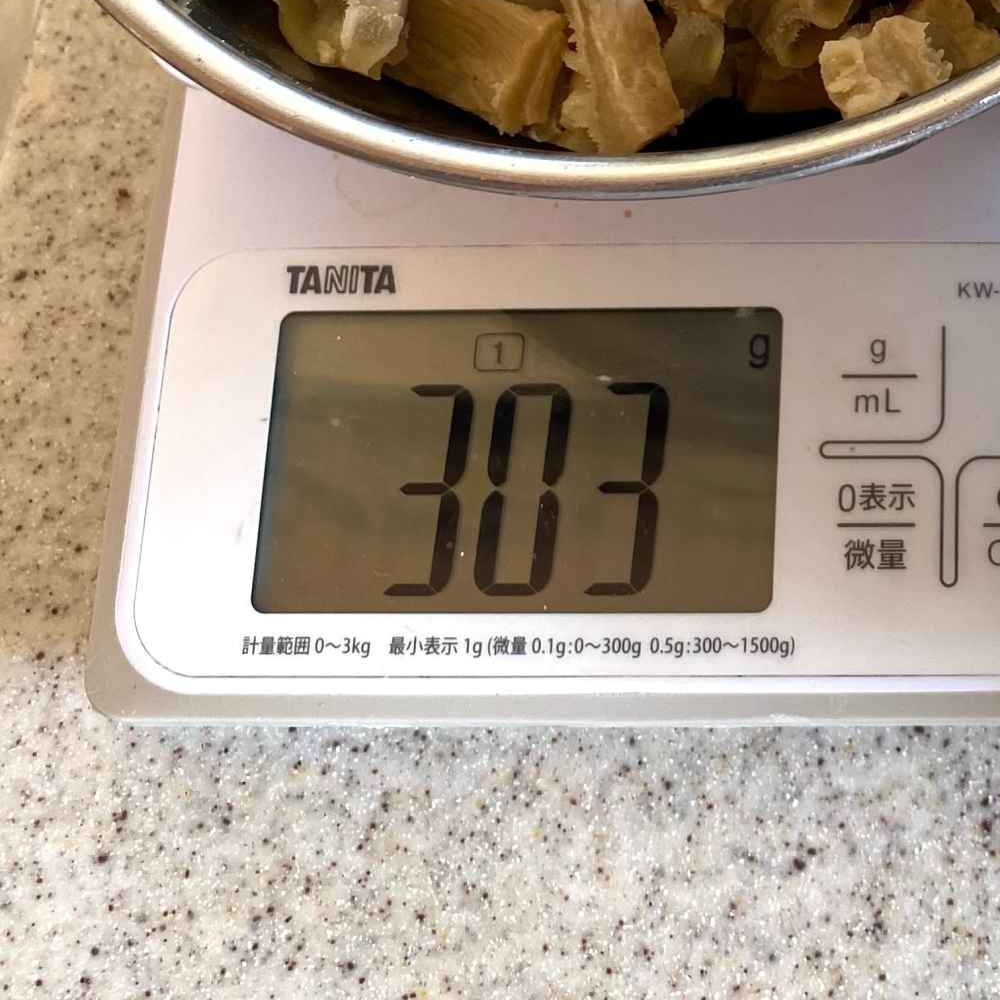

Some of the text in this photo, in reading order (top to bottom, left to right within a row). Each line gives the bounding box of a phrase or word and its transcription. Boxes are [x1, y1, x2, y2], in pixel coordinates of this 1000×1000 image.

[286, 264, 397, 295] TANITA
[748, 334, 771, 368] g
[869, 338, 887, 364] g
[854, 387, 902, 414] mL
[383, 382, 671, 596] 303
[837, 482, 916, 513] 0表示
[843, 539, 907, 571] 微量
[242, 635, 311, 656] 計量範囲
[388, 635, 458, 656] 最小表示
[464, 637, 483, 658] 1g
